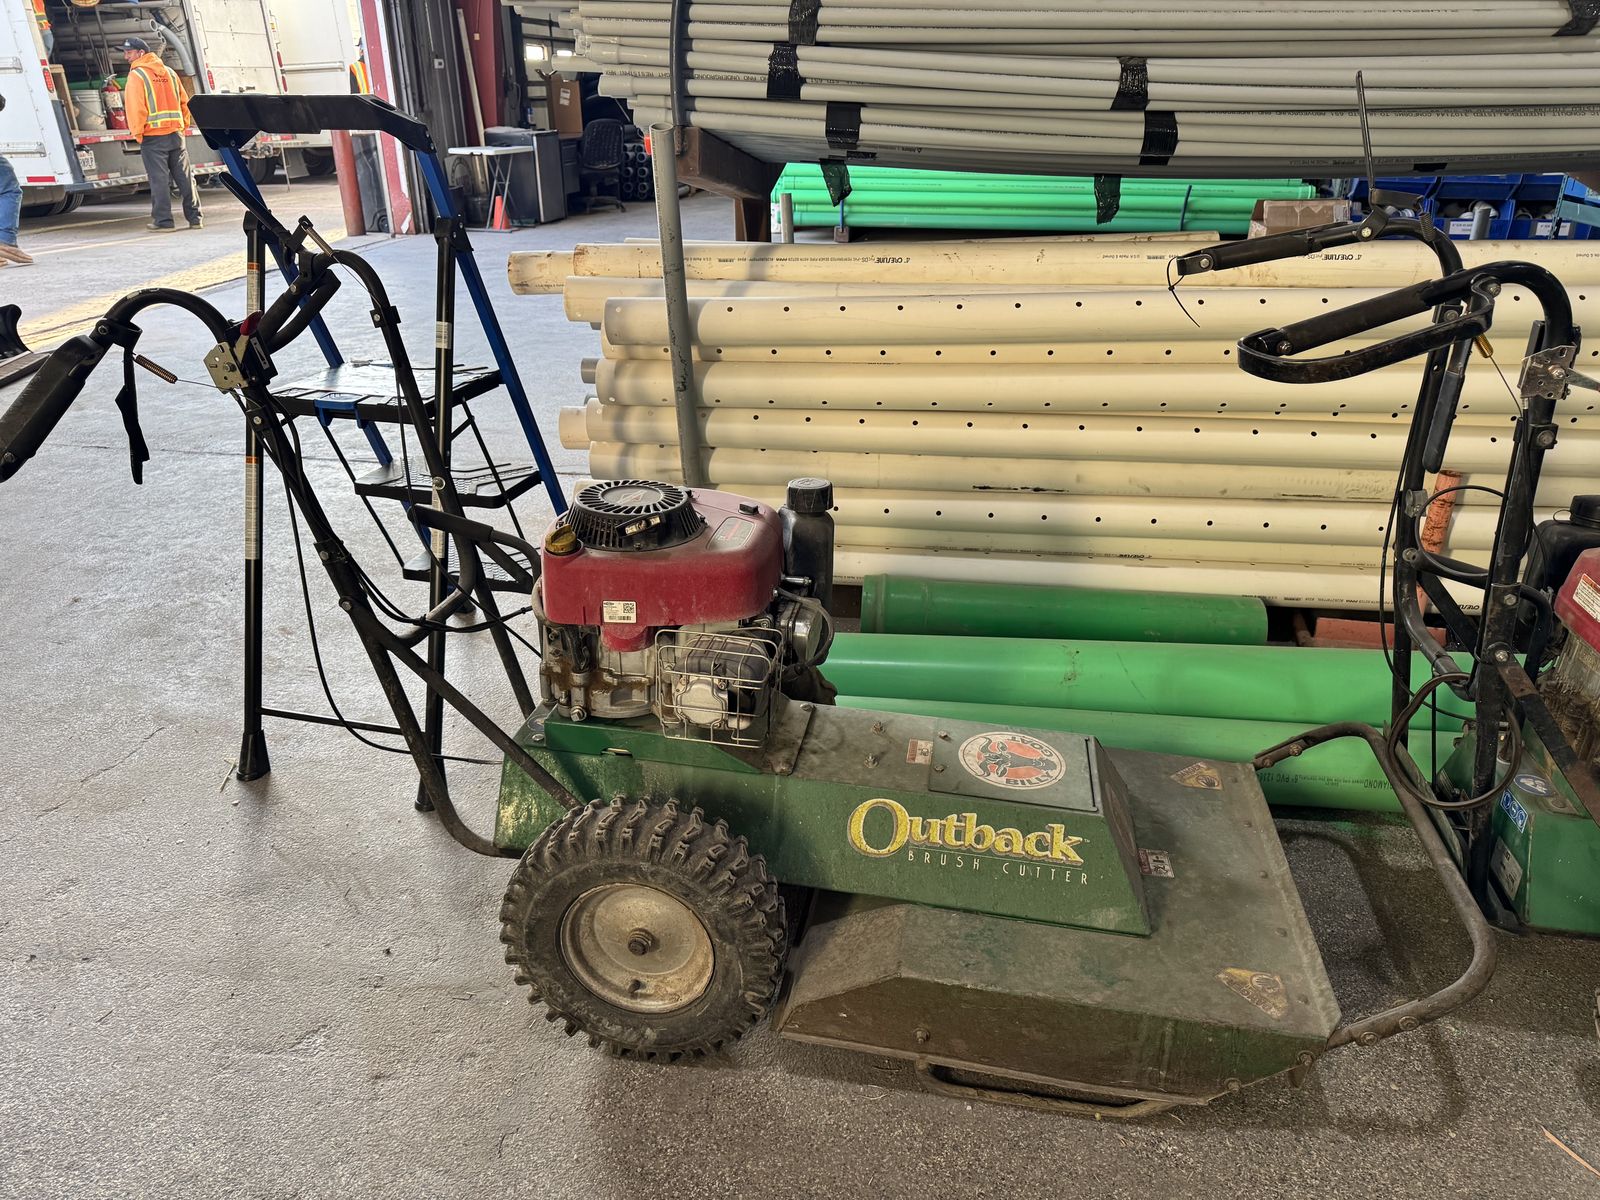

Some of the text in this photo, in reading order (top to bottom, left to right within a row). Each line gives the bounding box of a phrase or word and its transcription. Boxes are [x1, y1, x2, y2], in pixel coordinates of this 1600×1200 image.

[1009, 736, 1054, 757] GOAT
[1005, 771, 1055, 787] BILLY
[847, 797, 1085, 867] Outback
[908, 850, 1089, 885] BRUSH CUTTER
